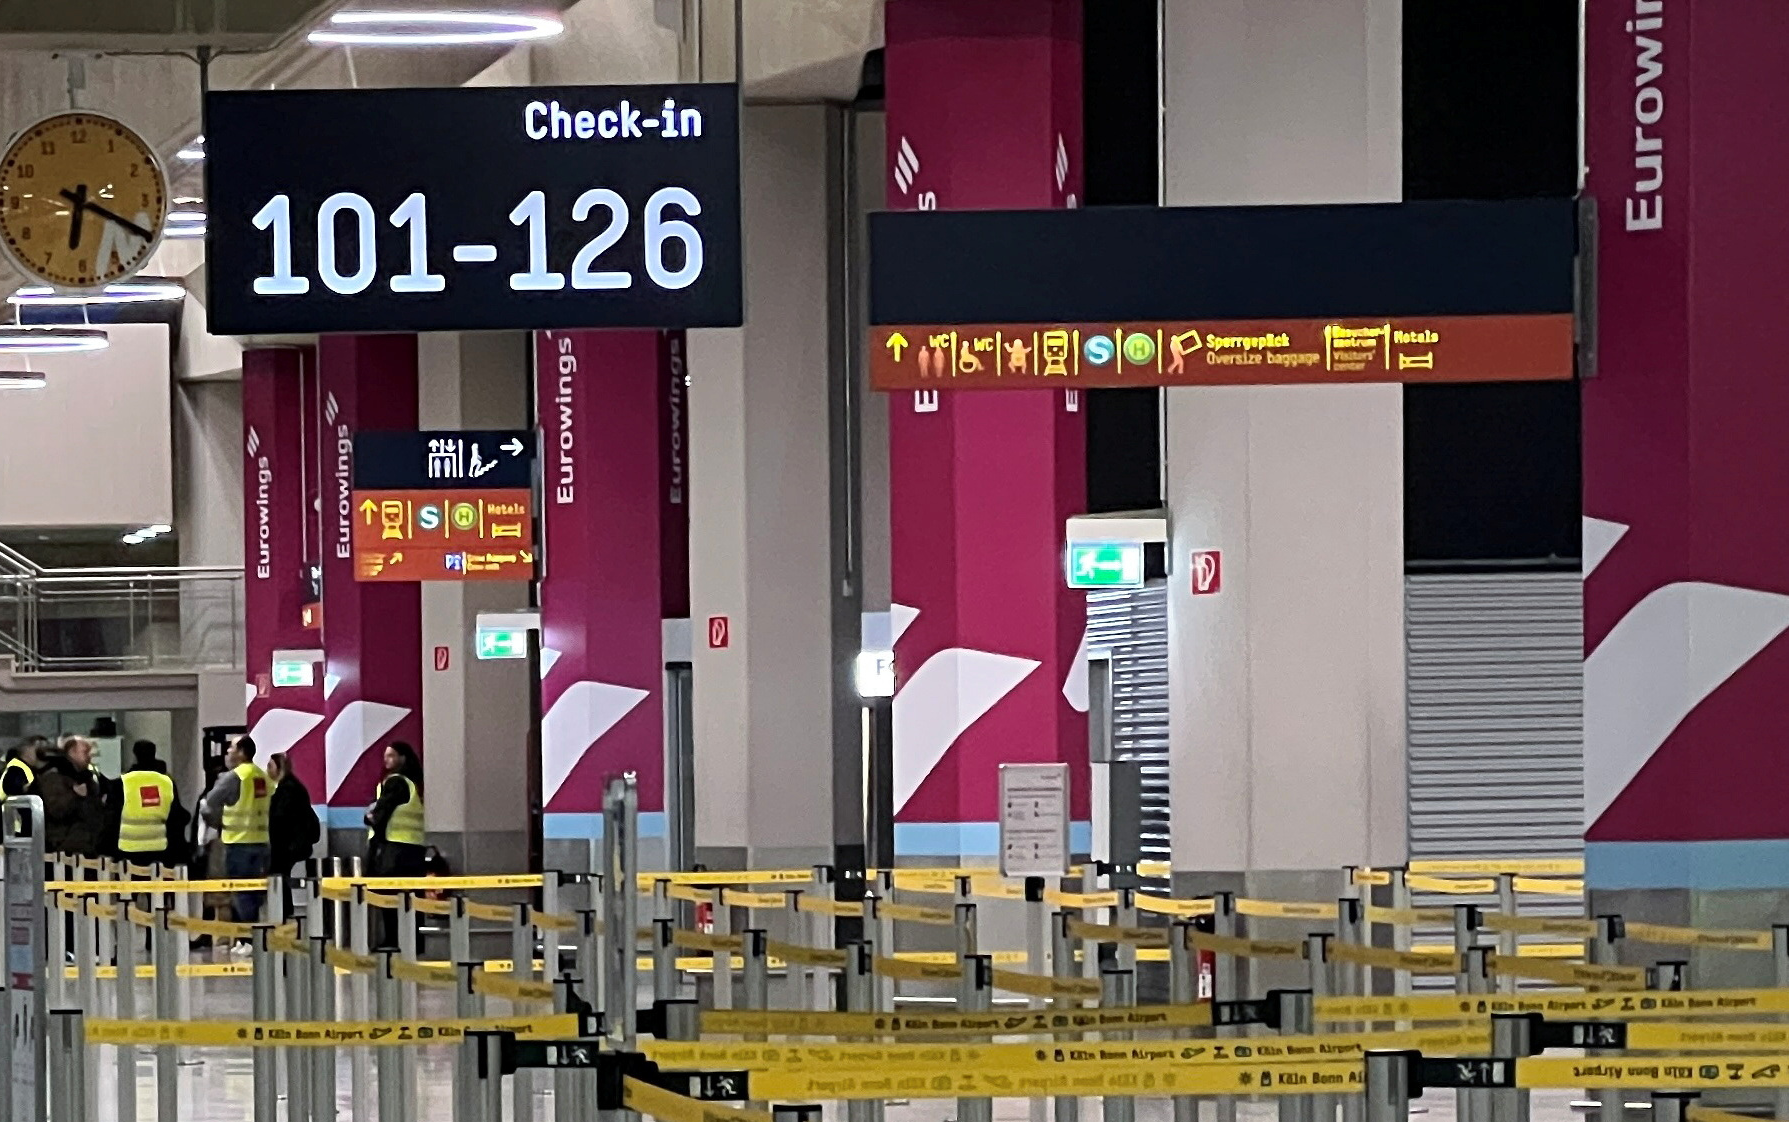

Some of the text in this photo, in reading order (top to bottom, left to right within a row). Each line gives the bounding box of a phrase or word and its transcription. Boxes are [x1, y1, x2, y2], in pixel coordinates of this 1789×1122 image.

[524, 98, 702, 139] Check-in
[1626, 0, 1663, 231] Eurowi
[71, 130, 87, 144] 12
[41, 141, 55, 155] 11
[17, 164, 34, 178] 10
[251, 186, 705, 296] 101-126
[929, 334, 950, 348] WC
[973, 337, 994, 351] WC
[1206, 351, 1321, 367] Oversize baggage
[555, 337, 578, 504] Eurowings
[336, 423, 353, 559] Eurowings
[256, 455, 272, 579] Eurowings
[1278, 1071, 1307, 1085] Köln
[1312, 1071, 1344, 1084] Bonn
